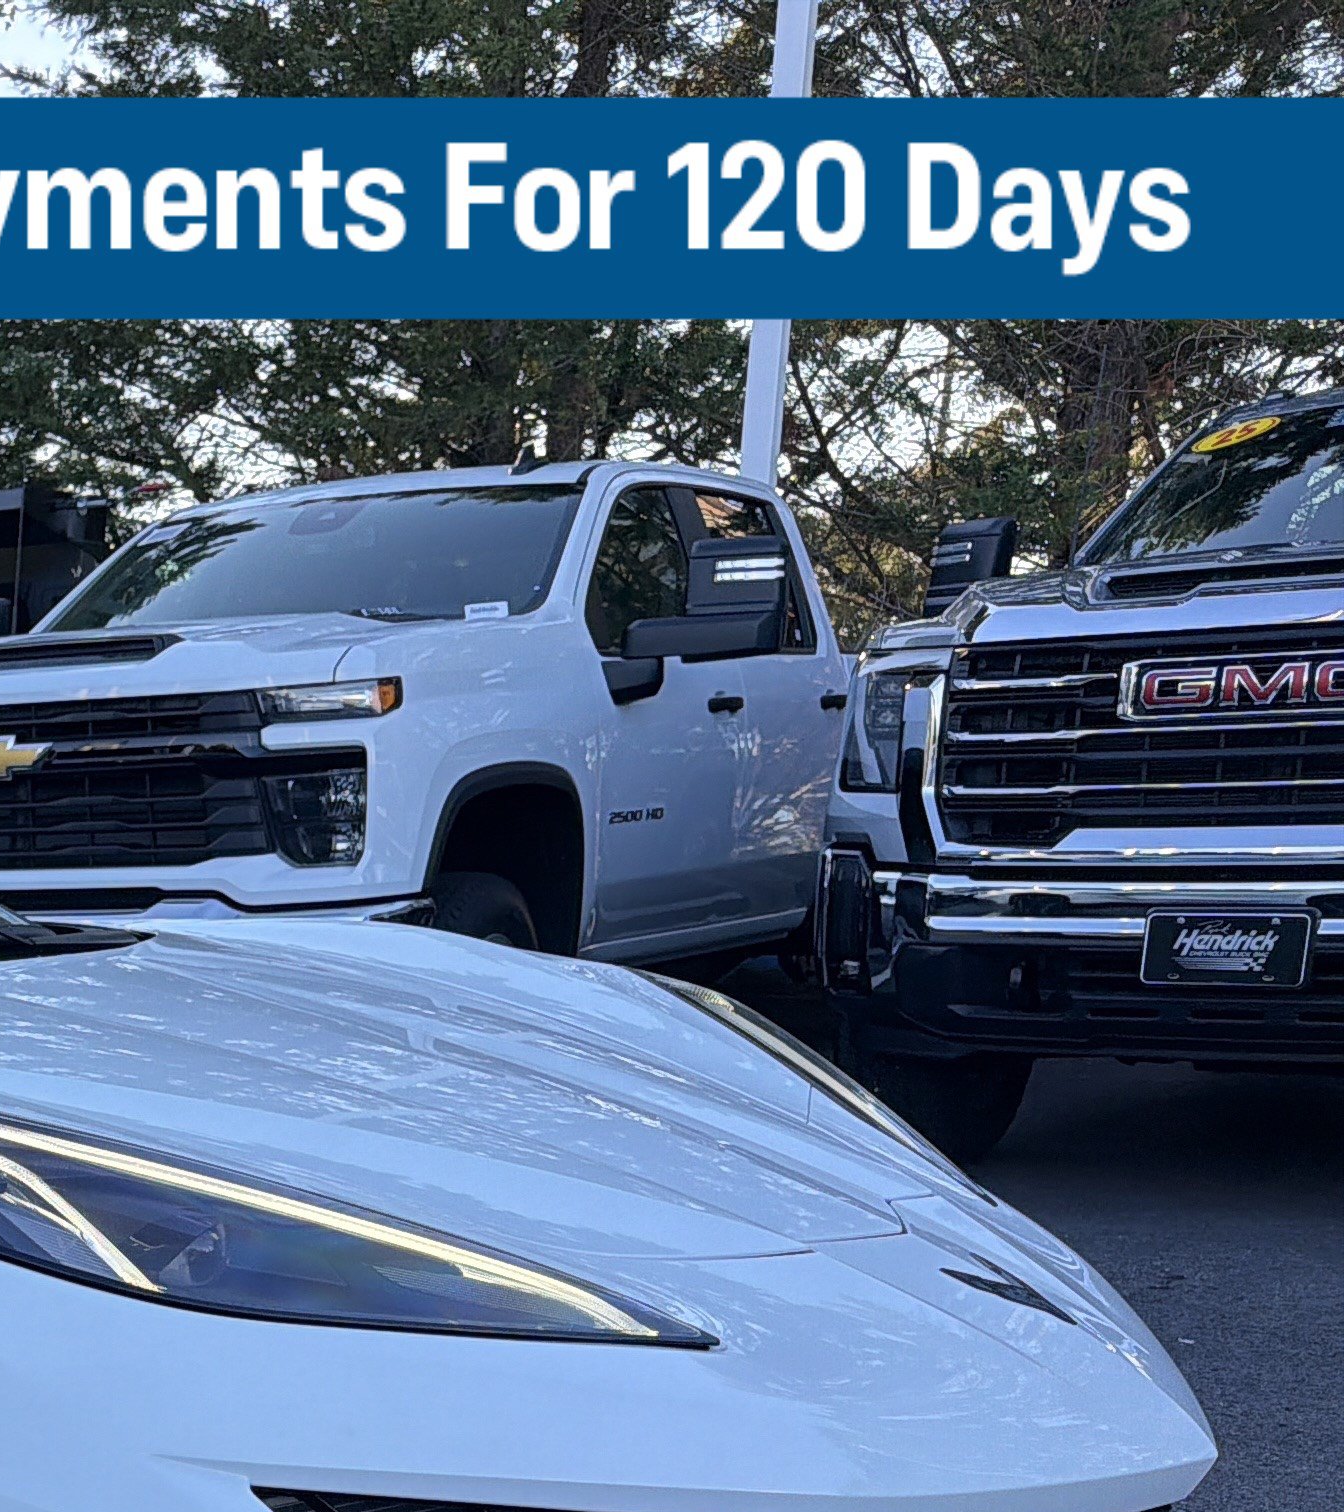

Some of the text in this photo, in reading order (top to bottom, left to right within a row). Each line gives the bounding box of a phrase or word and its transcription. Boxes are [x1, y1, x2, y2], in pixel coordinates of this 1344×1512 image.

[1211, 424, 1258, 448] 25
[609, 807, 664, 824] 2500 HD
[1173, 929, 1280, 956] Hendrick
